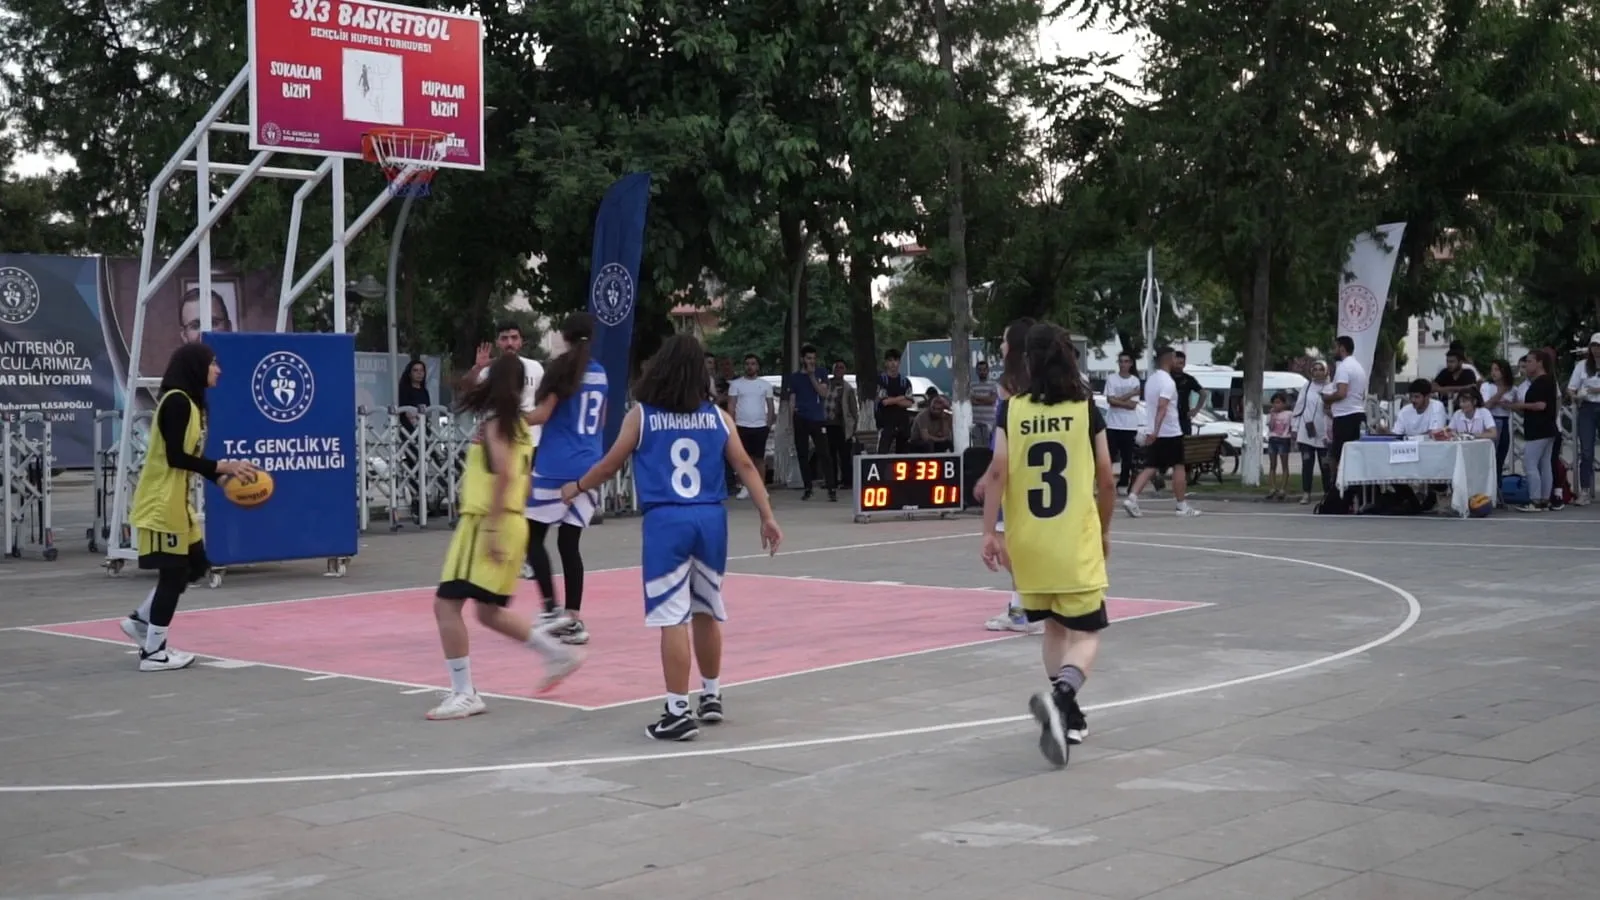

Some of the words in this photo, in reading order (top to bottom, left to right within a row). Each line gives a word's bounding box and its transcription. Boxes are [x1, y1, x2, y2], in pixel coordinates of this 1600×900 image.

[290, 0, 331, 22] 3X3
[338, 3, 450, 41] BASKETBOL
[310, 26, 349, 41] GENÇLİK
[351, 32, 382, 46] KUPASI
[270, 60, 322, 81] SOKAKLAR
[282, 82, 311, 99] BİZİM
[422, 80, 465, 99] KUPALAR
[431, 100, 458, 118] BİZİM
[0, 357, 93, 370] CULARIMIZA
[18, 372, 92, 386] DİLİYORUM
[41, 400, 93, 410] KASAPOĞLU
[577, 390, 603, 435] 13
[649, 411, 717, 432] DİYARBAKIR
[1020, 415, 1074, 435] SİİRT
[223, 439, 252, 455] T.C.
[254, 435, 319, 457] GENÇLİK
[321, 437, 341, 452] VE
[264, 453, 345, 472] BAKANLIĞI
[670, 437, 701, 498] 8
[867, 463, 881, 481] A
[896, 461, 907, 480] 9
[915, 461, 938, 480] 33
[944, 461, 955, 479] B
[1027, 440, 1068, 518] 3
[864, 487, 887, 507] 00
[934, 485, 957, 504] 01
